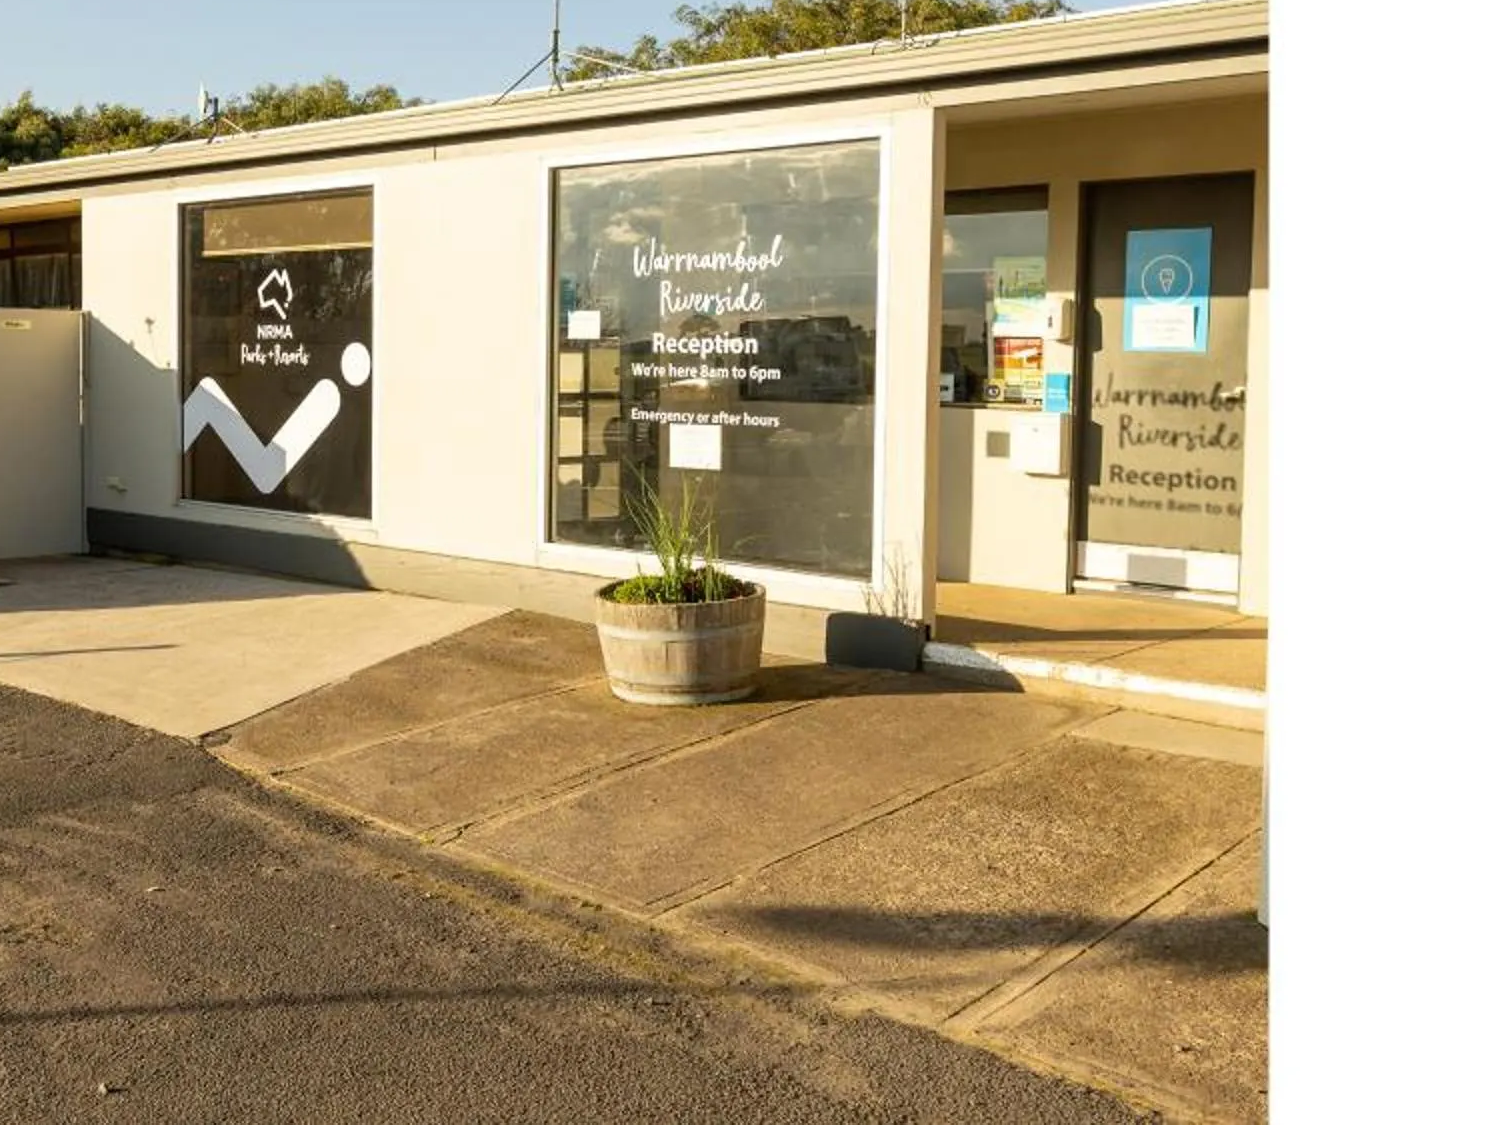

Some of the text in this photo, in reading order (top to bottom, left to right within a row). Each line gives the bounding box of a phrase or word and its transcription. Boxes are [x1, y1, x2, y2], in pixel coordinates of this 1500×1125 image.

[633, 234, 783, 278] Warrnambool
[660, 280, 765, 316] Riverside
[257, 324, 293, 340] NRMA
[652, 332, 759, 360] Reception
[631, 363, 781, 384] We're here 8am to 6pm
[631, 407, 780, 427] Emergency or after hours
[1118, 414, 1242, 452] Riverside
[1108, 463, 1237, 493] Reception
[1127, 495, 1163, 510] here
[1167, 498, 1202, 514] 8am
[1205, 502, 1223, 516] to
